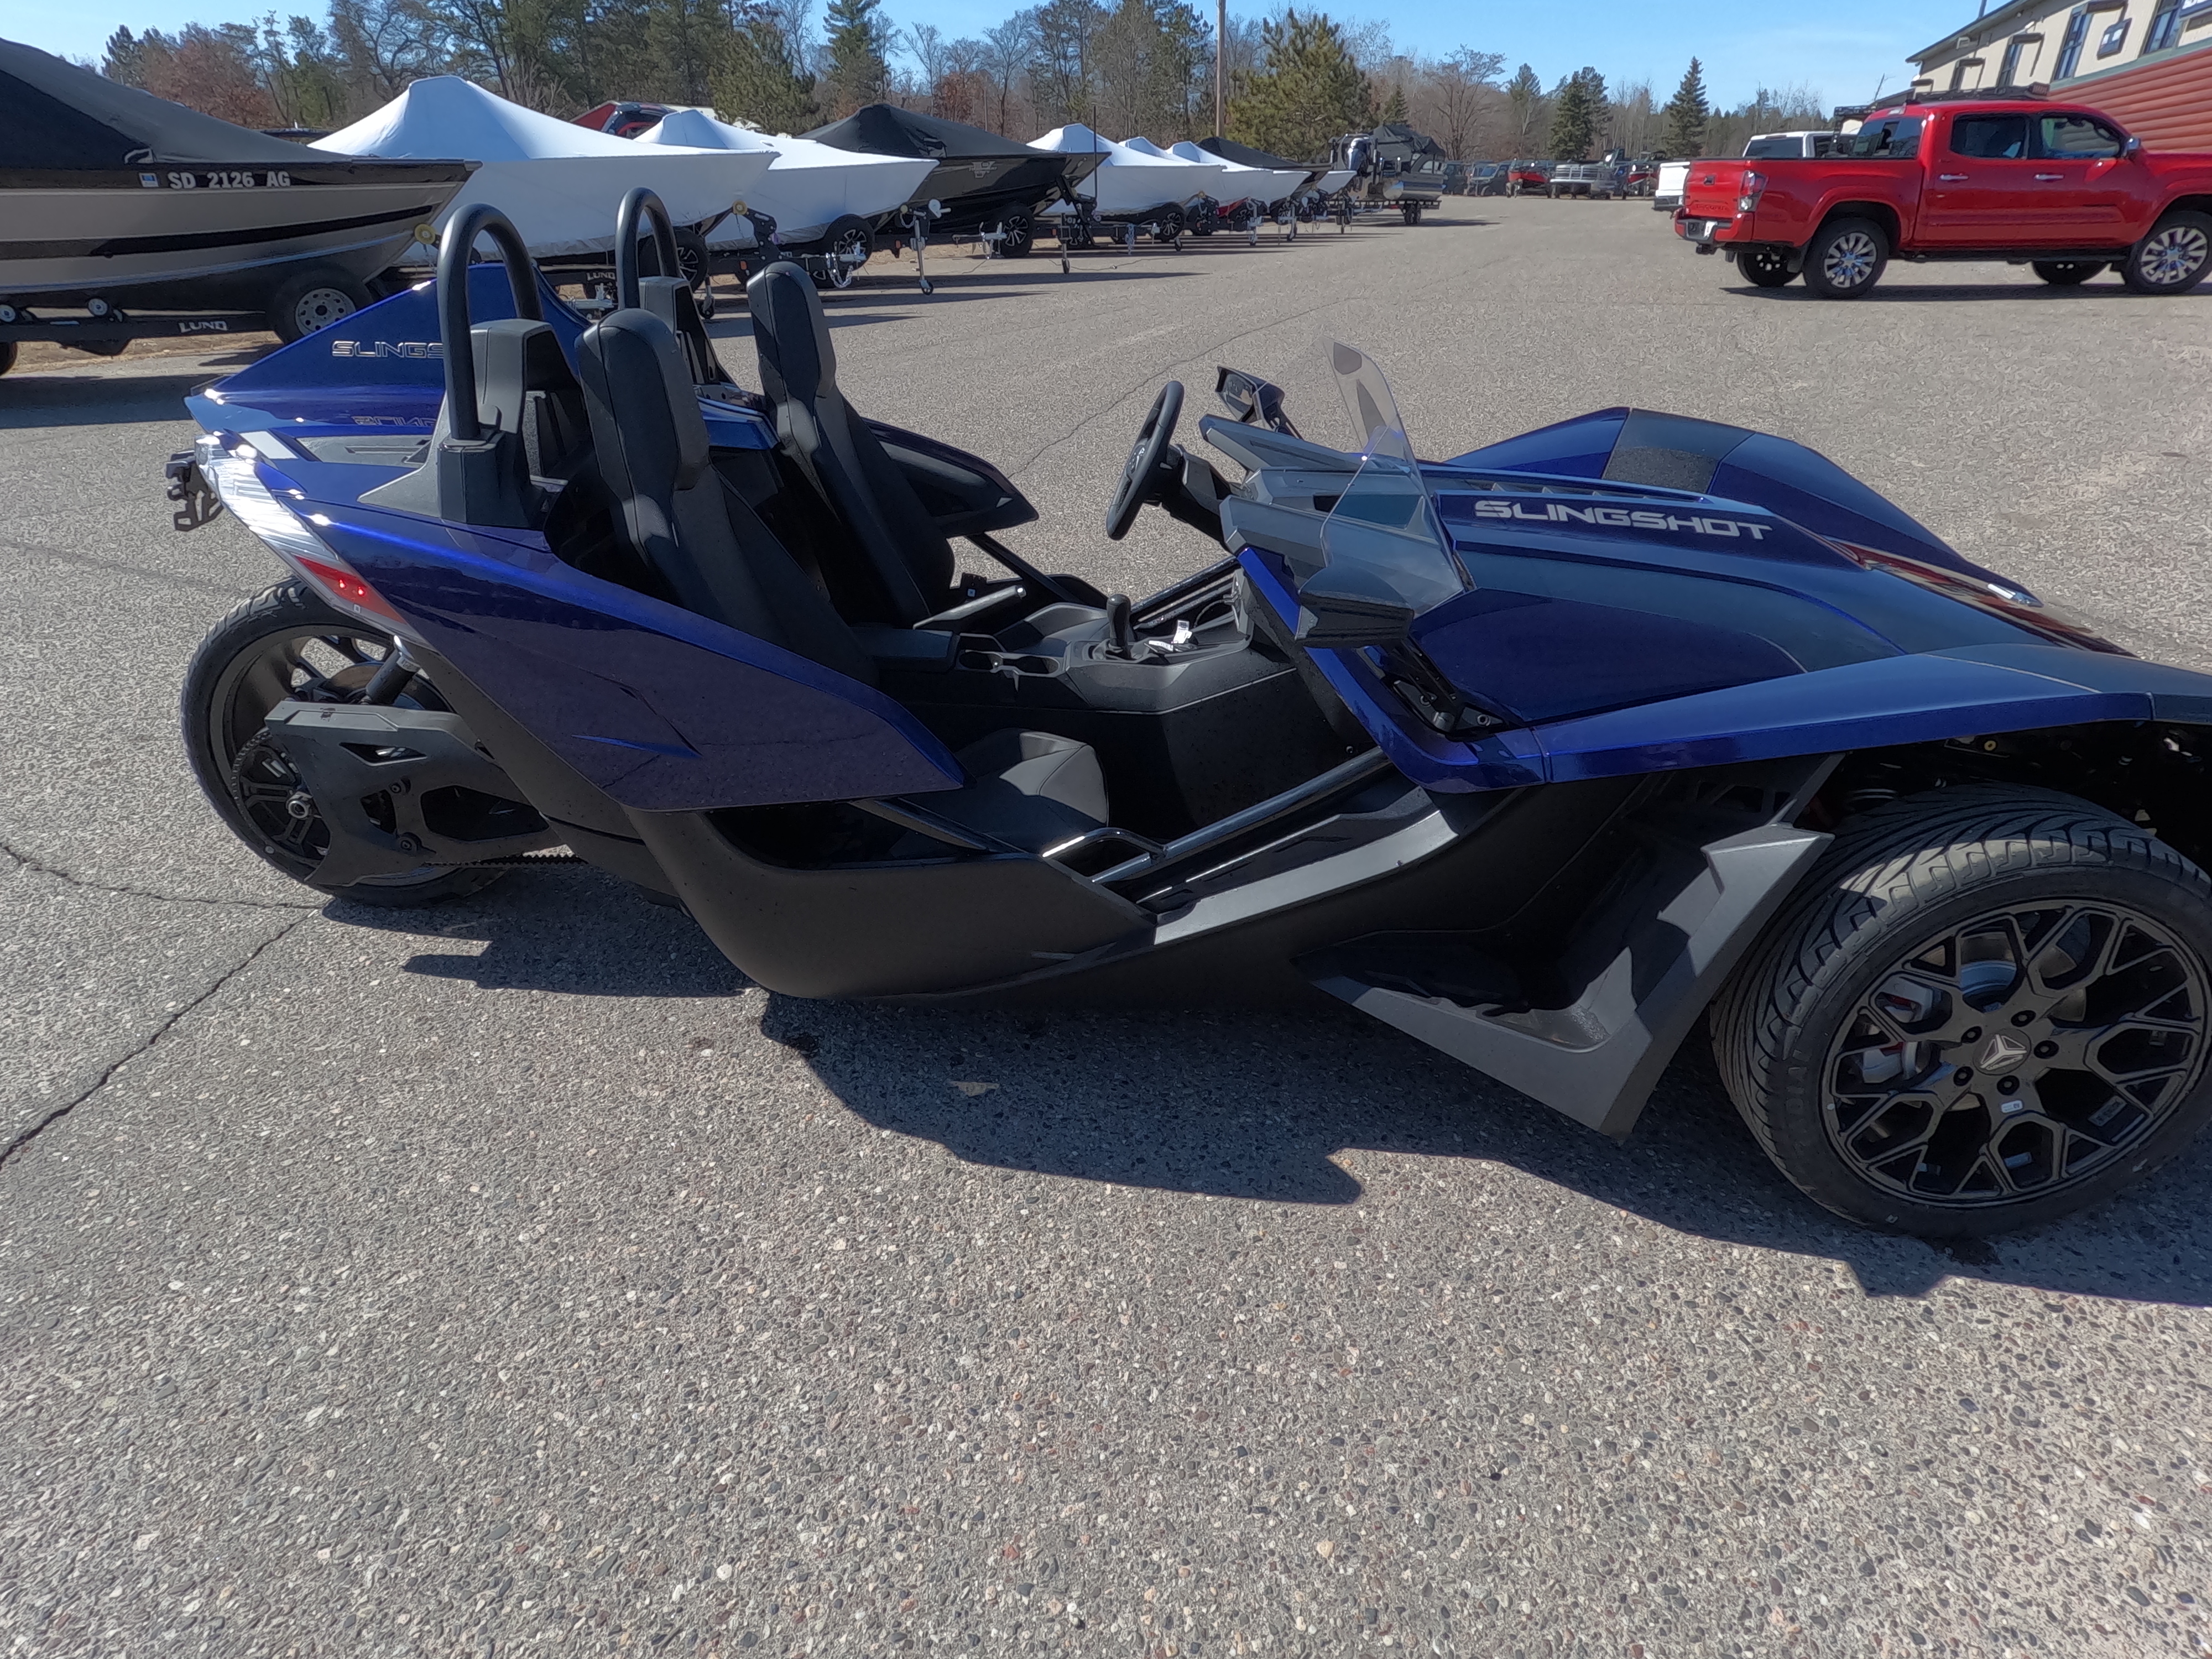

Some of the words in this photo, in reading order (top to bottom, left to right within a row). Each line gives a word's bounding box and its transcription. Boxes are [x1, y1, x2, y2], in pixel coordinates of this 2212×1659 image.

[168, 171, 196, 189] SD
[207, 171, 255, 189] 2126
[266, 171, 291, 187] AG
[586, 272, 615, 281] LUND
[178, 321, 228, 333] LUND
[1475, 500, 1773, 540] SLINGSHOT
